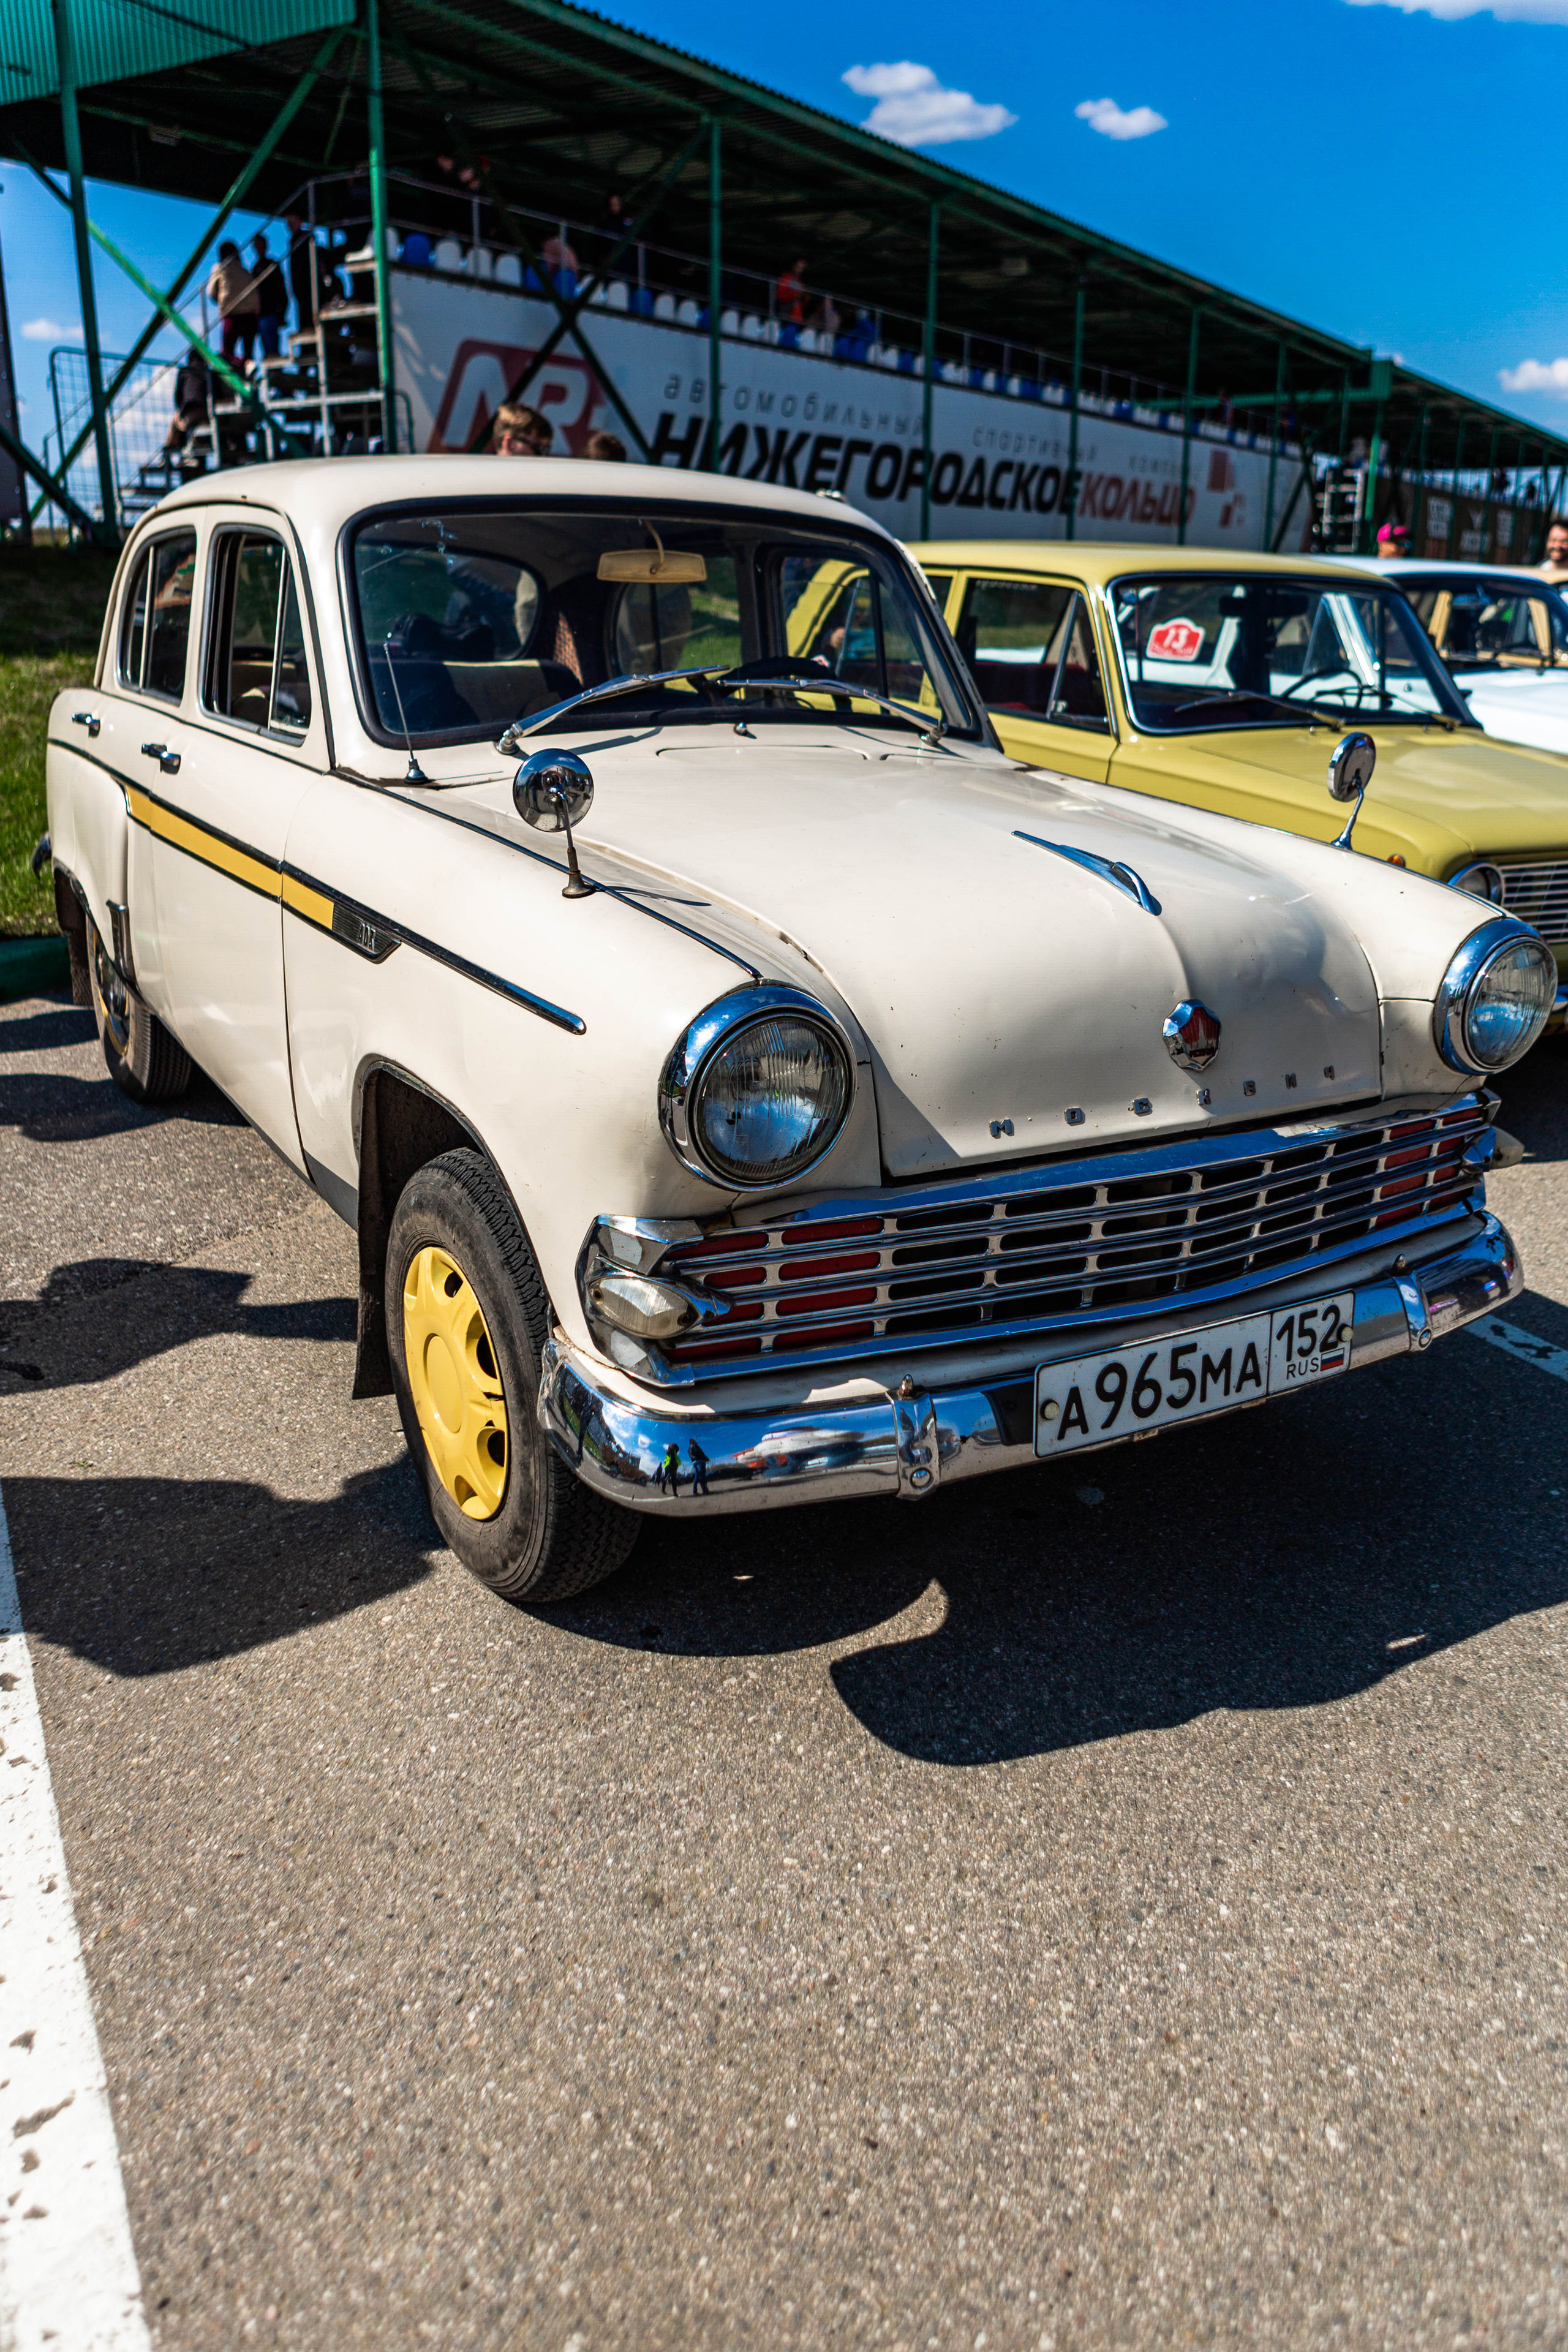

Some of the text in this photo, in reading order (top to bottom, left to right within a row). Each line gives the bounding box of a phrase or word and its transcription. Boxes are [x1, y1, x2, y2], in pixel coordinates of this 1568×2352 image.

[989, 1065, 1335, 1139] МОСКВИЧ
[1057, 1304, 1341, 1441] А965МА 152
[1286, 1356, 1319, 1381] RUS
